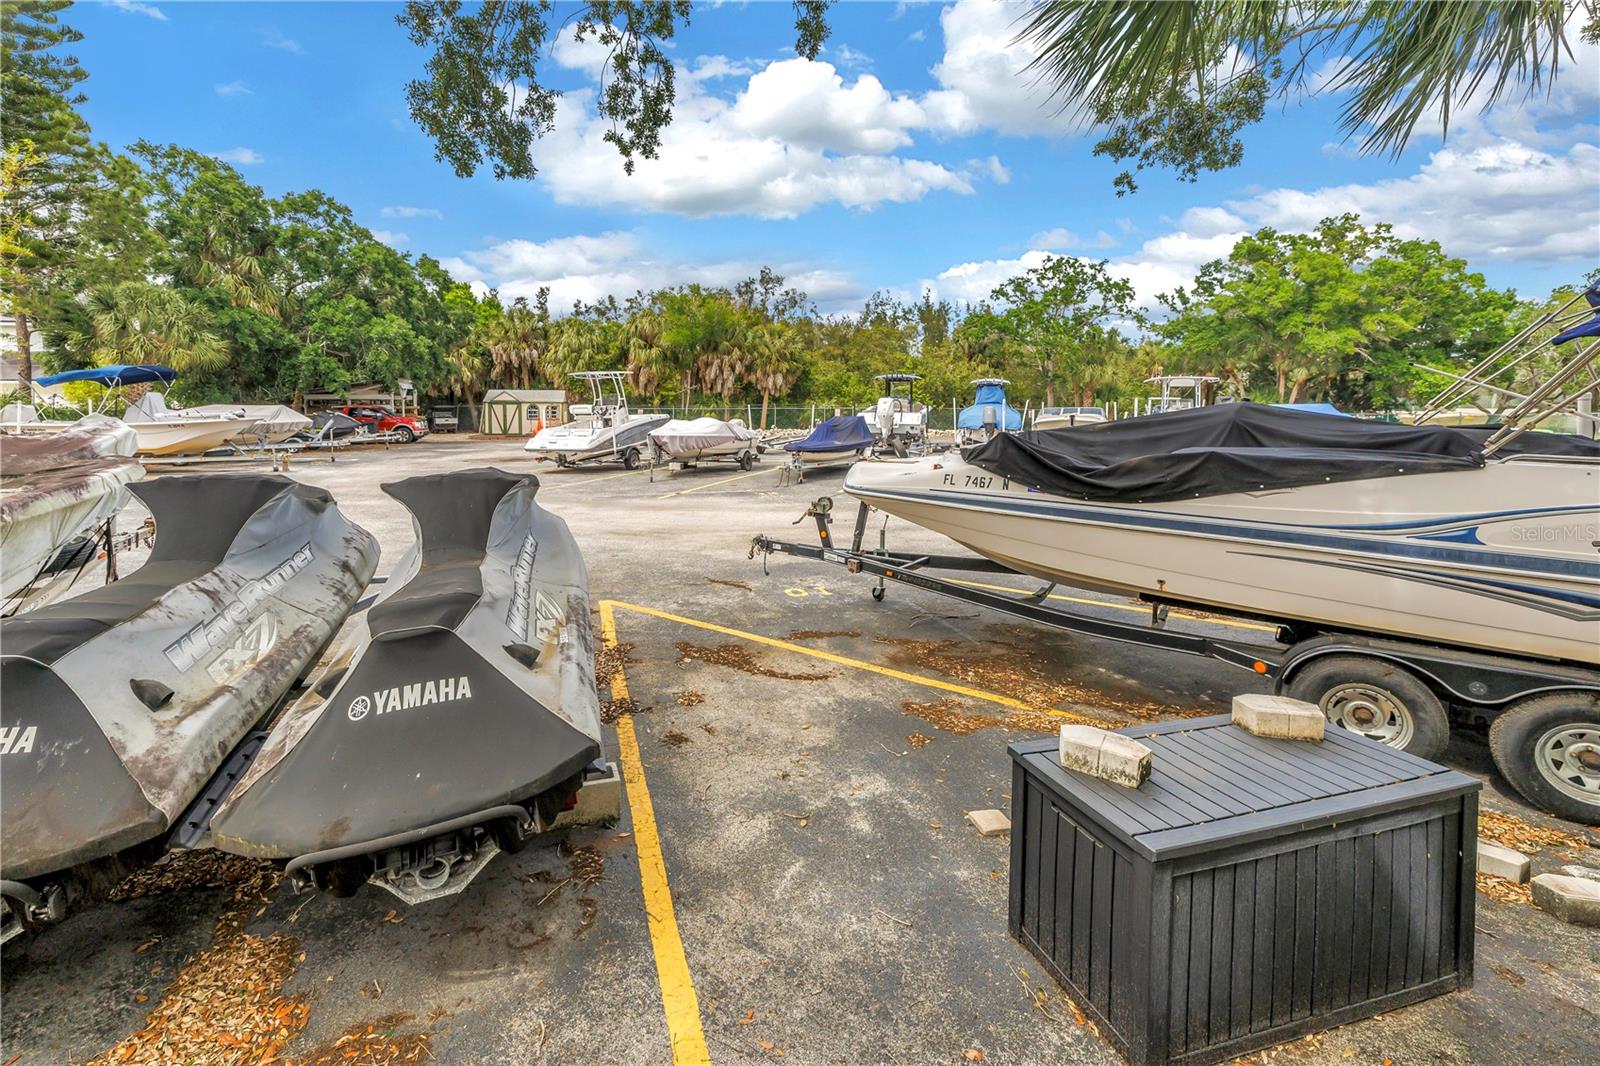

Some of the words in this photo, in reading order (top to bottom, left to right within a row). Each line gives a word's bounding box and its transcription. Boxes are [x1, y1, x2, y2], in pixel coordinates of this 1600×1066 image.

[943, 473, 956, 486] FL
[965, 475, 993, 489] 7467
[1002, 478, 1010, 491] N
[164, 541, 316, 673] WaveRunner
[373, 676, 472, 715] YAMAHA
